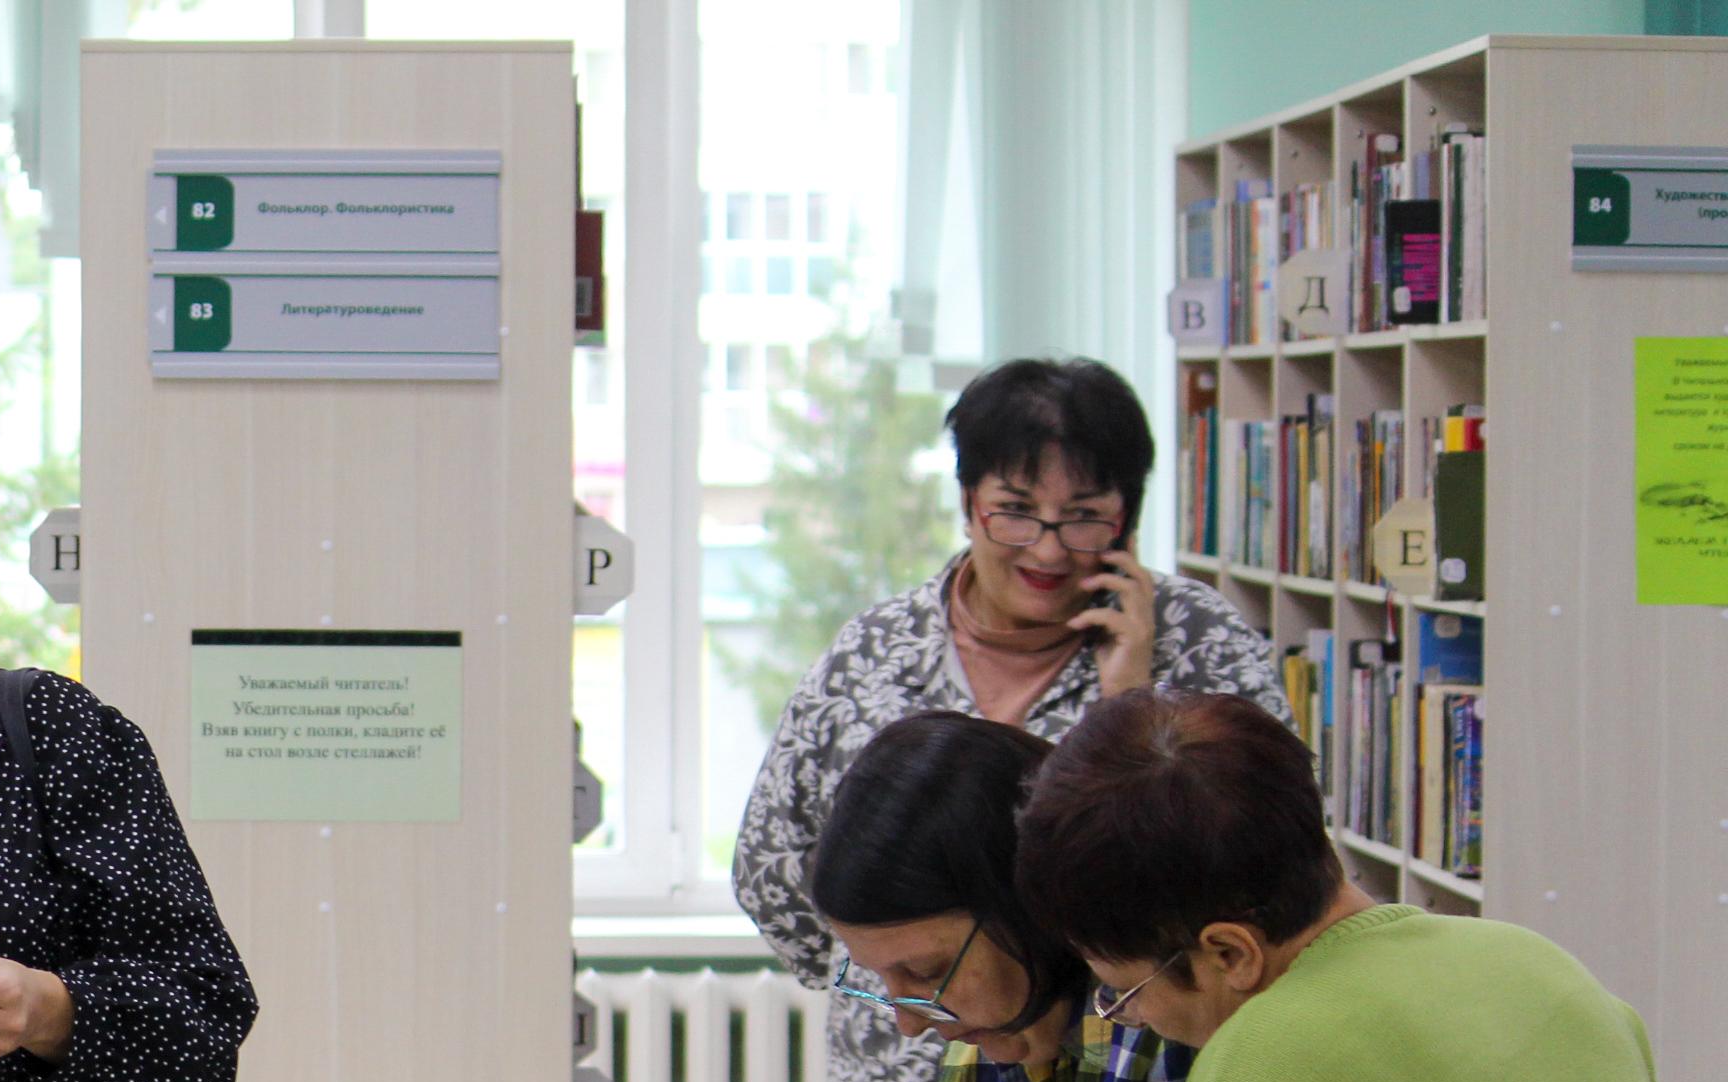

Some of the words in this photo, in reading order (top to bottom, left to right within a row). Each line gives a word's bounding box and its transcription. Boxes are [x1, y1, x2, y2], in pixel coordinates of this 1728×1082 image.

[192, 202, 215, 219] 82
[257, 201, 333, 217] Фольклор.
[336, 200, 455, 217] Фольклористика
[1589, 197, 1612, 213] 84
[1297, 276, 1330, 315] Д
[190, 302, 213, 319] 83
[282, 302, 425, 318] Литературоведение
[1182, 300, 1206, 328] В
[52, 534, 80, 571] Н
[1399, 529, 1428, 568] Е
[587, 548, 613, 586] Р
[239, 674, 329, 692] Уважаемый
[334, 675, 410, 691] читатель!
[233, 701, 341, 718] Убедительная
[347, 700, 414, 718] просьба!
[202, 723, 238, 738] Взяв
[243, 726, 288, 741] книгу
[293, 728, 301, 738] с
[306, 727, 357, 741] полки,
[363, 726, 425, 740] кладите
[225, 747, 244, 759] на
[248, 747, 282, 759] стол
[287, 747, 330, 759] возле
[334, 744, 422, 760] стеллажей!
